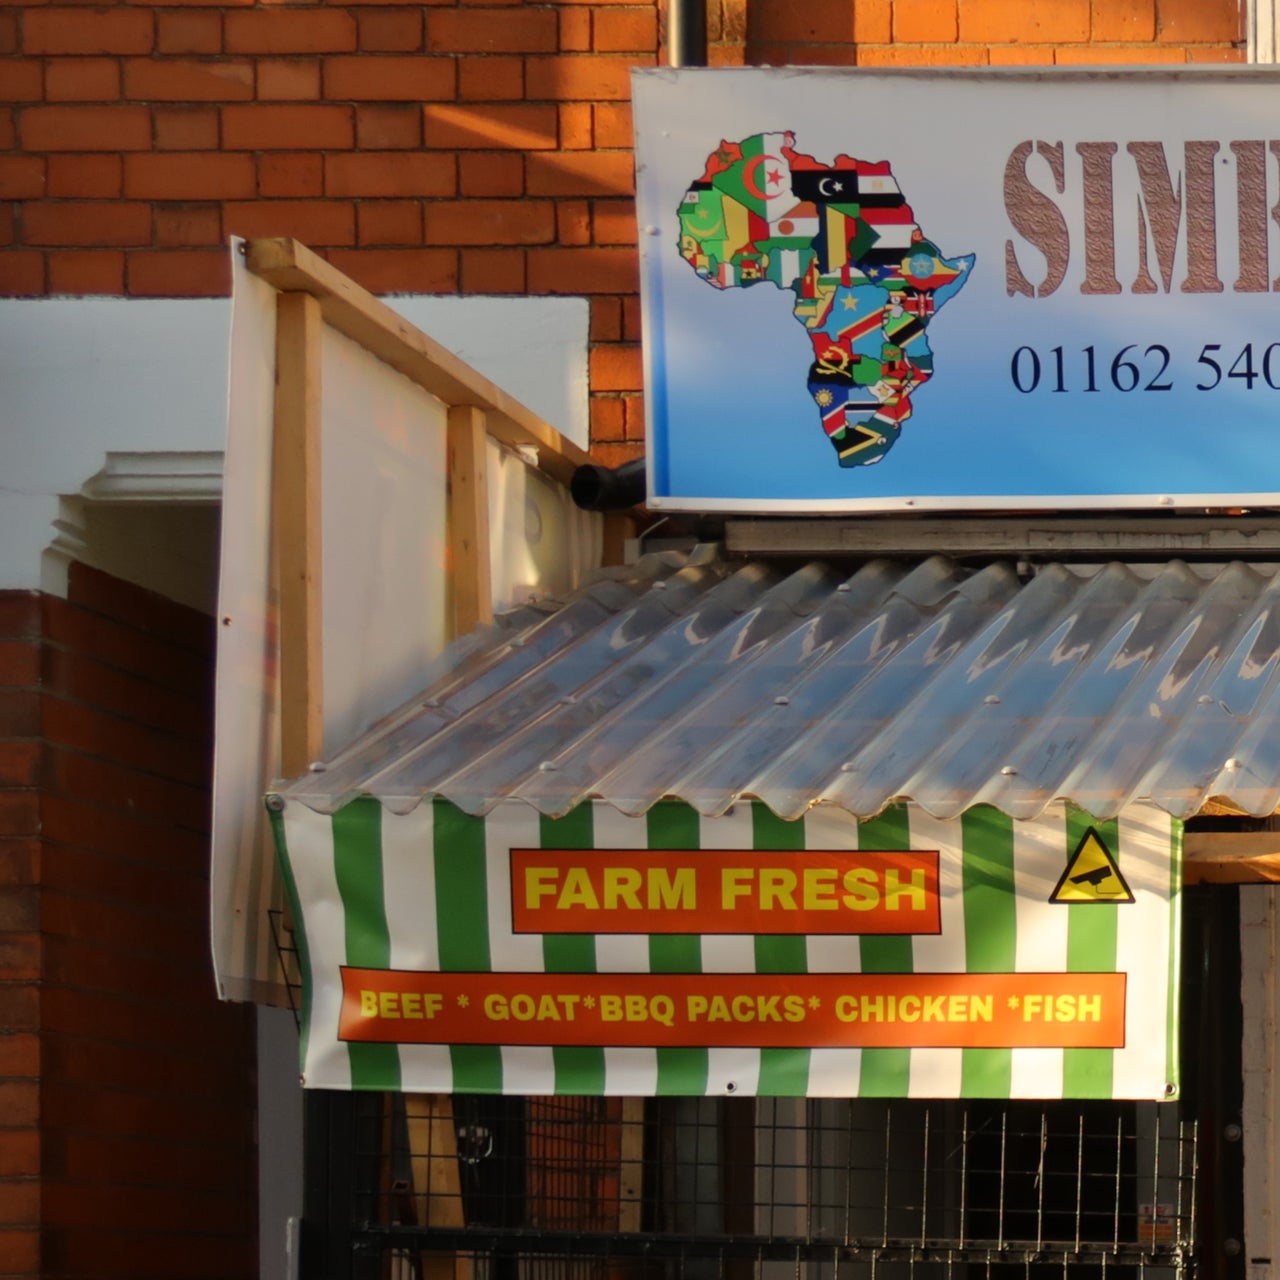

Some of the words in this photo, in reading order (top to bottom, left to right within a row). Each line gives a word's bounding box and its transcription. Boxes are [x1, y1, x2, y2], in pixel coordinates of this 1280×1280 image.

[1011, 345, 1172, 394] 01162
[525, 867, 697, 910] FARM
[722, 867, 926, 911] FRESH
[360, 989, 443, 1020] BEEF
[835, 995, 993, 1023] CHICKEN
